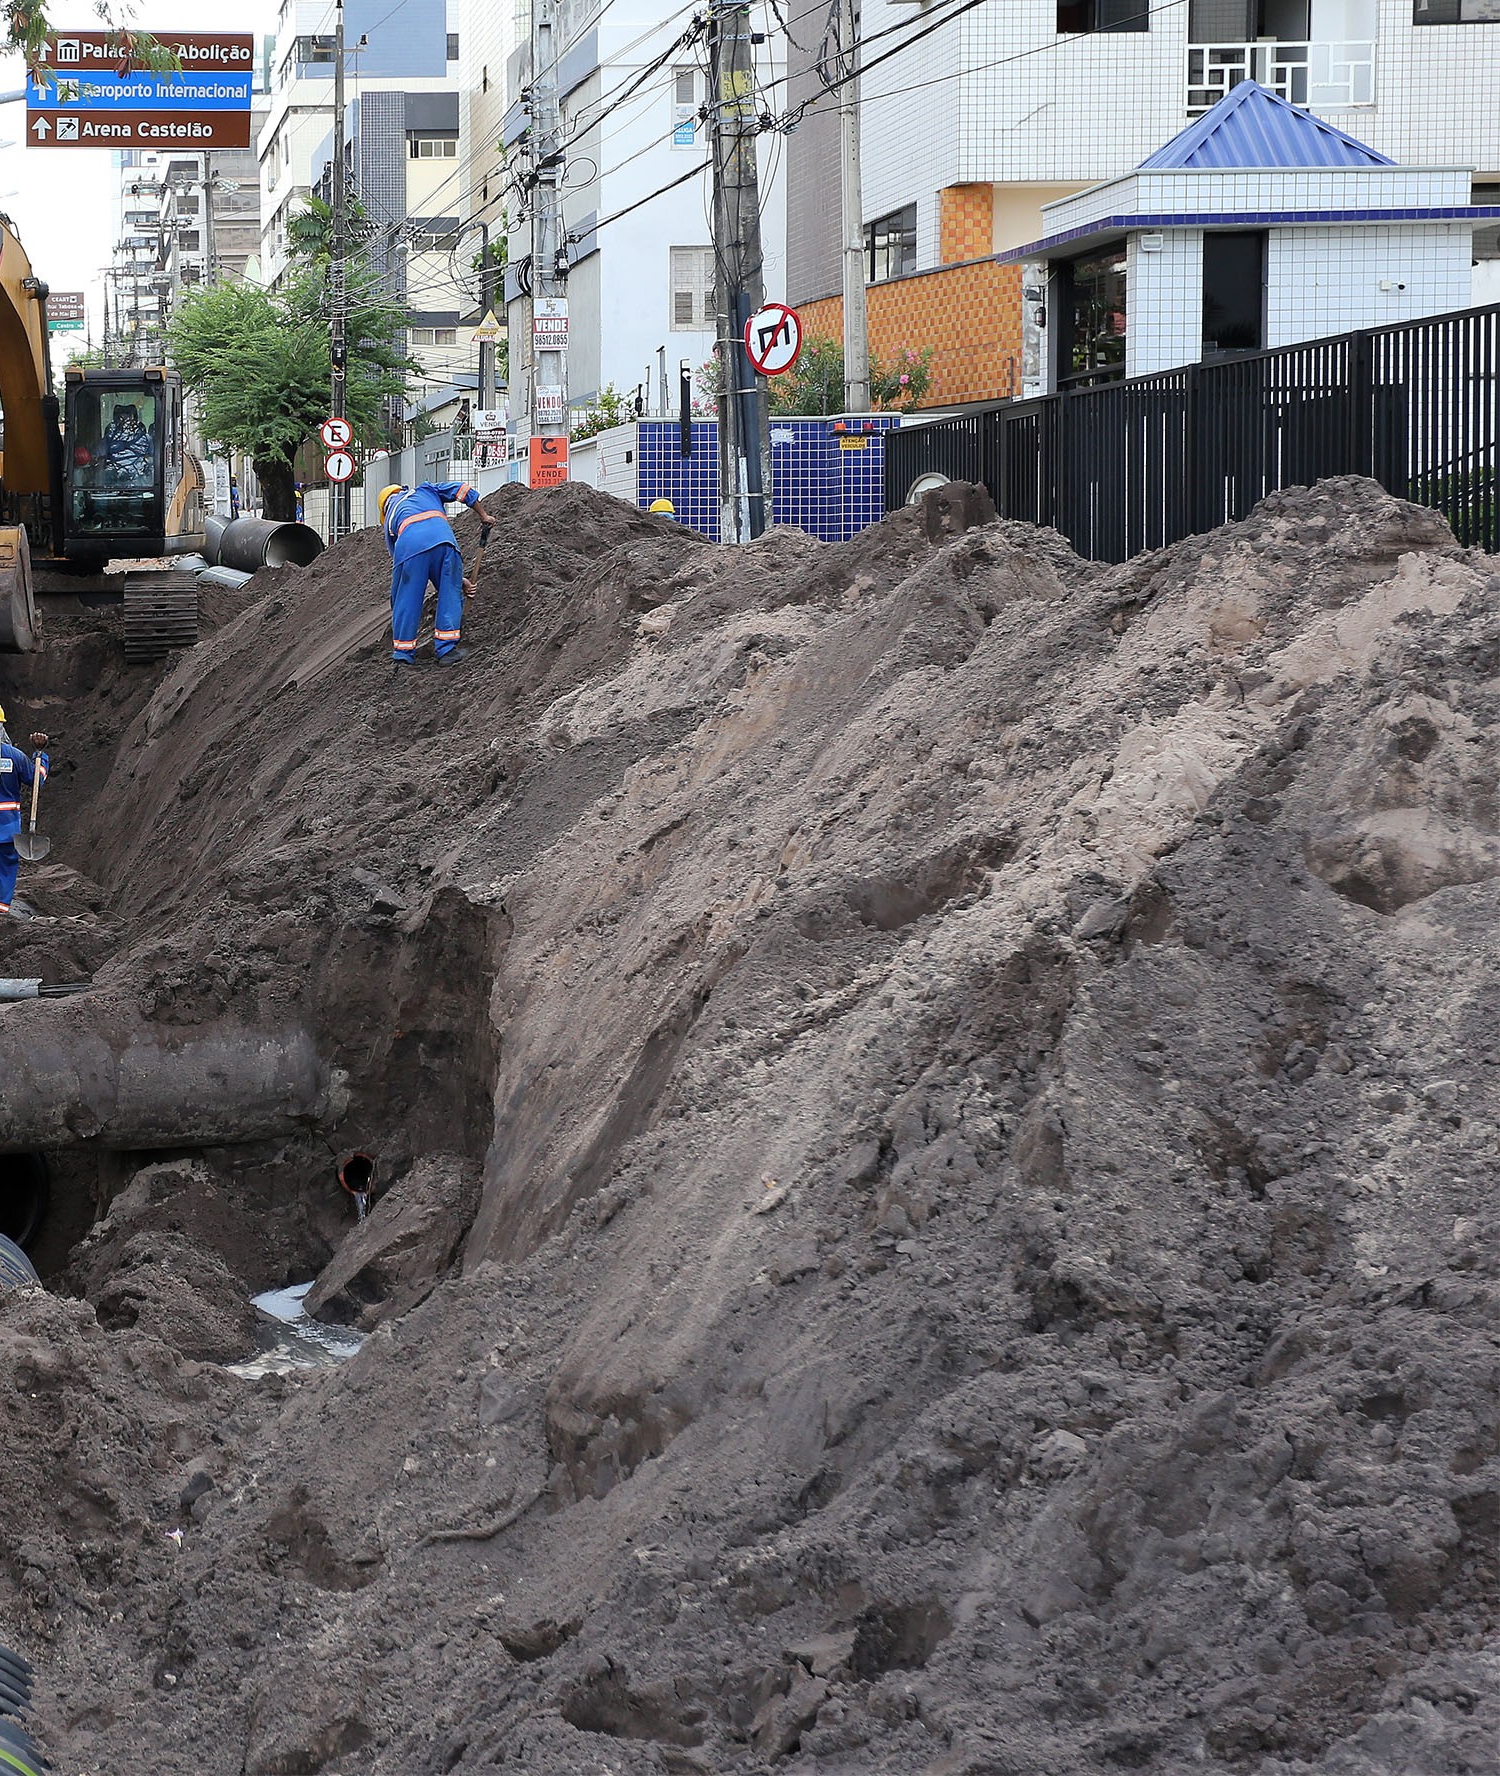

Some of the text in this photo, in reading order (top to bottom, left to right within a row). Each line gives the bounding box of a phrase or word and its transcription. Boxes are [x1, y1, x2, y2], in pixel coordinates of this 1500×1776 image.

[177, 44, 251, 64] Abolição
[83, 83, 248, 101] Aeroporto Internacional
[82, 121, 214, 138] Arena Castelão
[535, 319, 568, 332] VENDE
[537, 397, 561, 409] VENDO
[331, 426, 342, 442] E
[536, 470, 563, 478] VENDE
